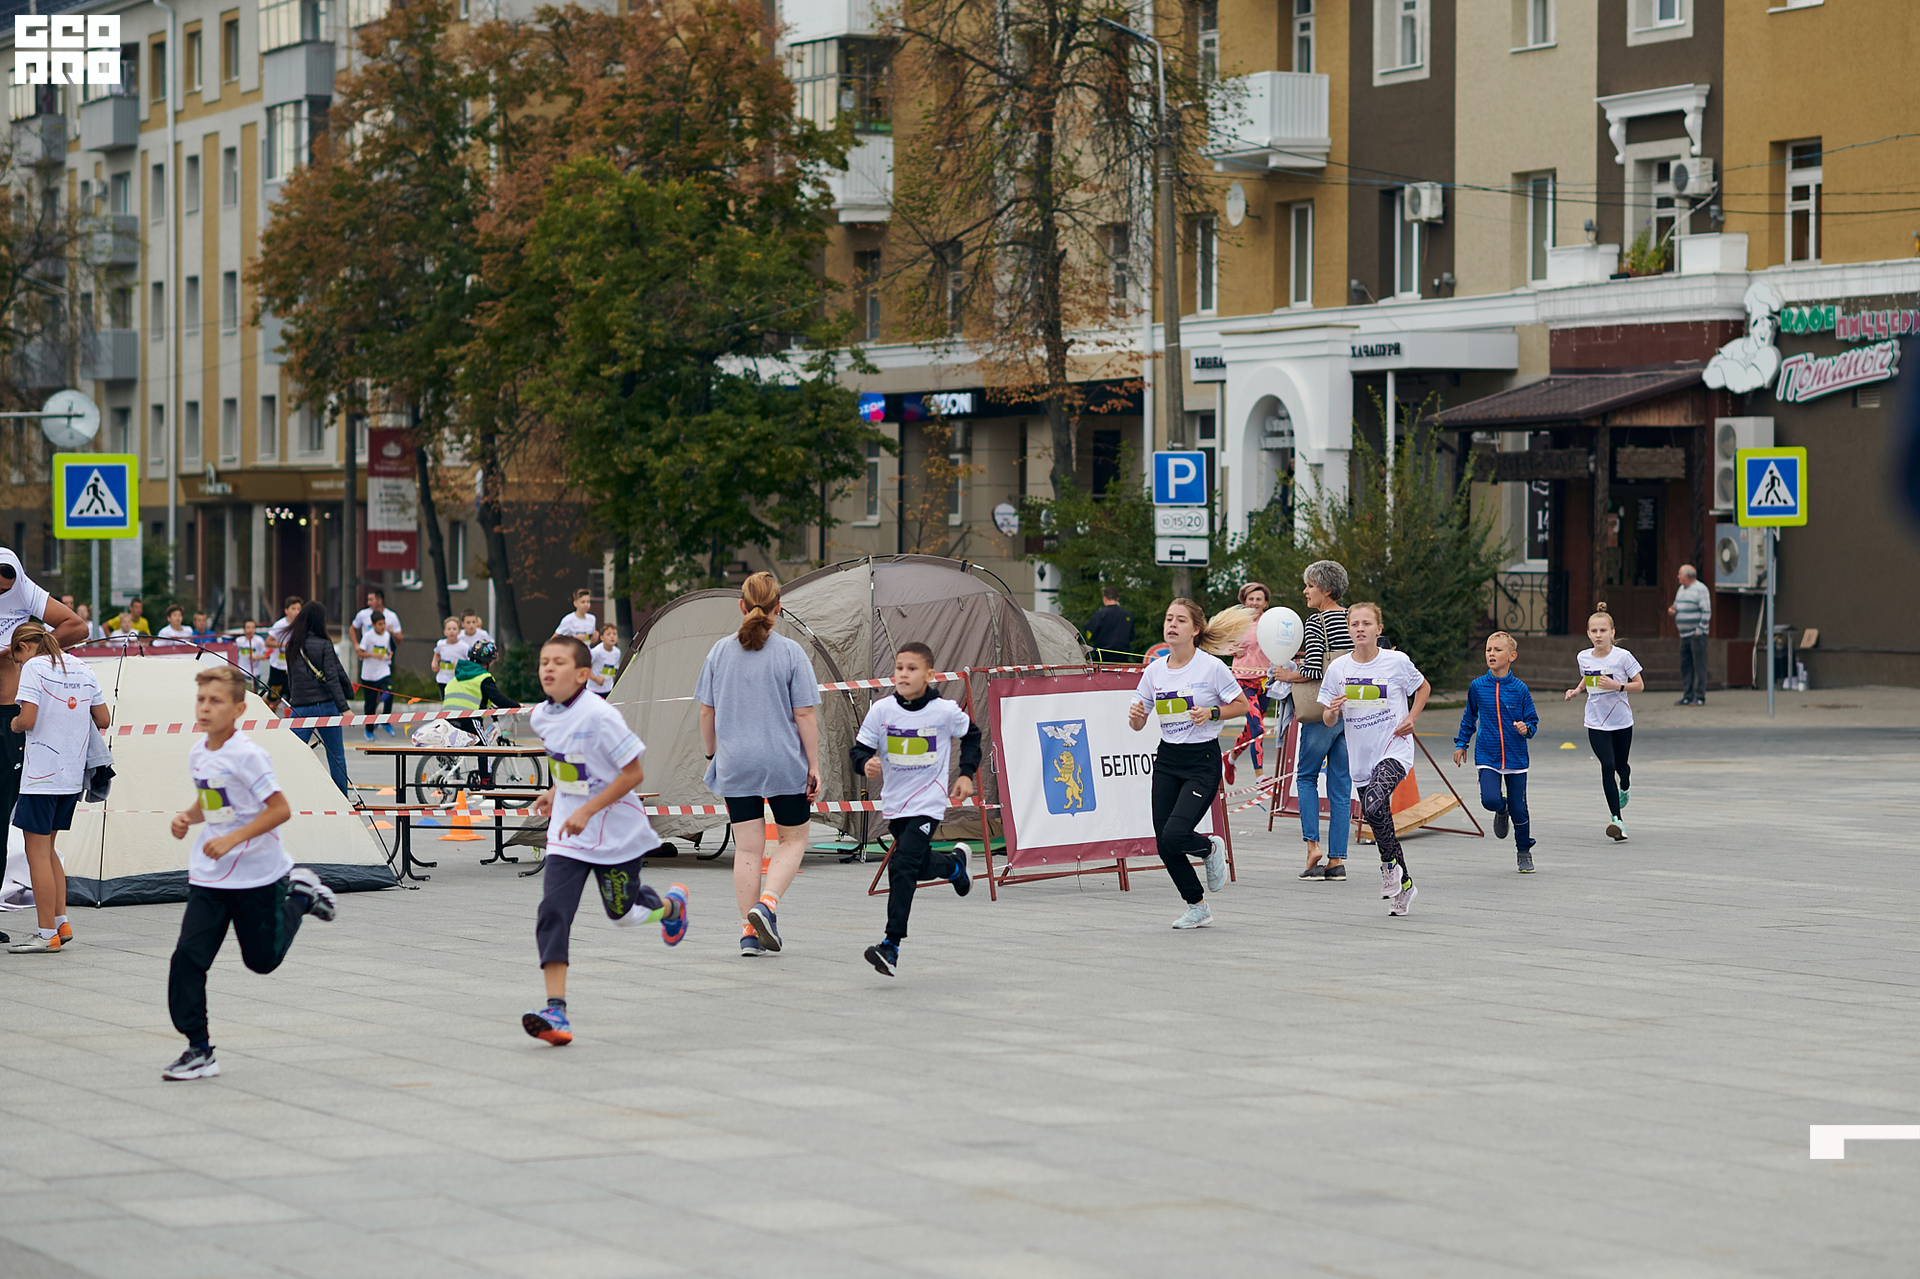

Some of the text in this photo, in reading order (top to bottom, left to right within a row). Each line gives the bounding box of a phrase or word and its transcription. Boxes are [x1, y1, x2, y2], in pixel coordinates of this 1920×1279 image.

[1781, 305, 1836, 334] КАФЕ
[1351, 342, 1400, 358] ХАЧАПУРИ
[930, 393, 972, 415] OZON
[1168, 458, 1196, 499] P
[1173, 517, 1183, 527] 15
[1187, 516, 1201, 527] 20
[1591, 676, 1596, 687] 1
[1357, 685, 1365, 700] 1
[1166, 699, 1173, 714] 1
[901, 738, 909, 755] 1
[554, 762, 560, 780] 1
[201, 790, 209, 810] 1
